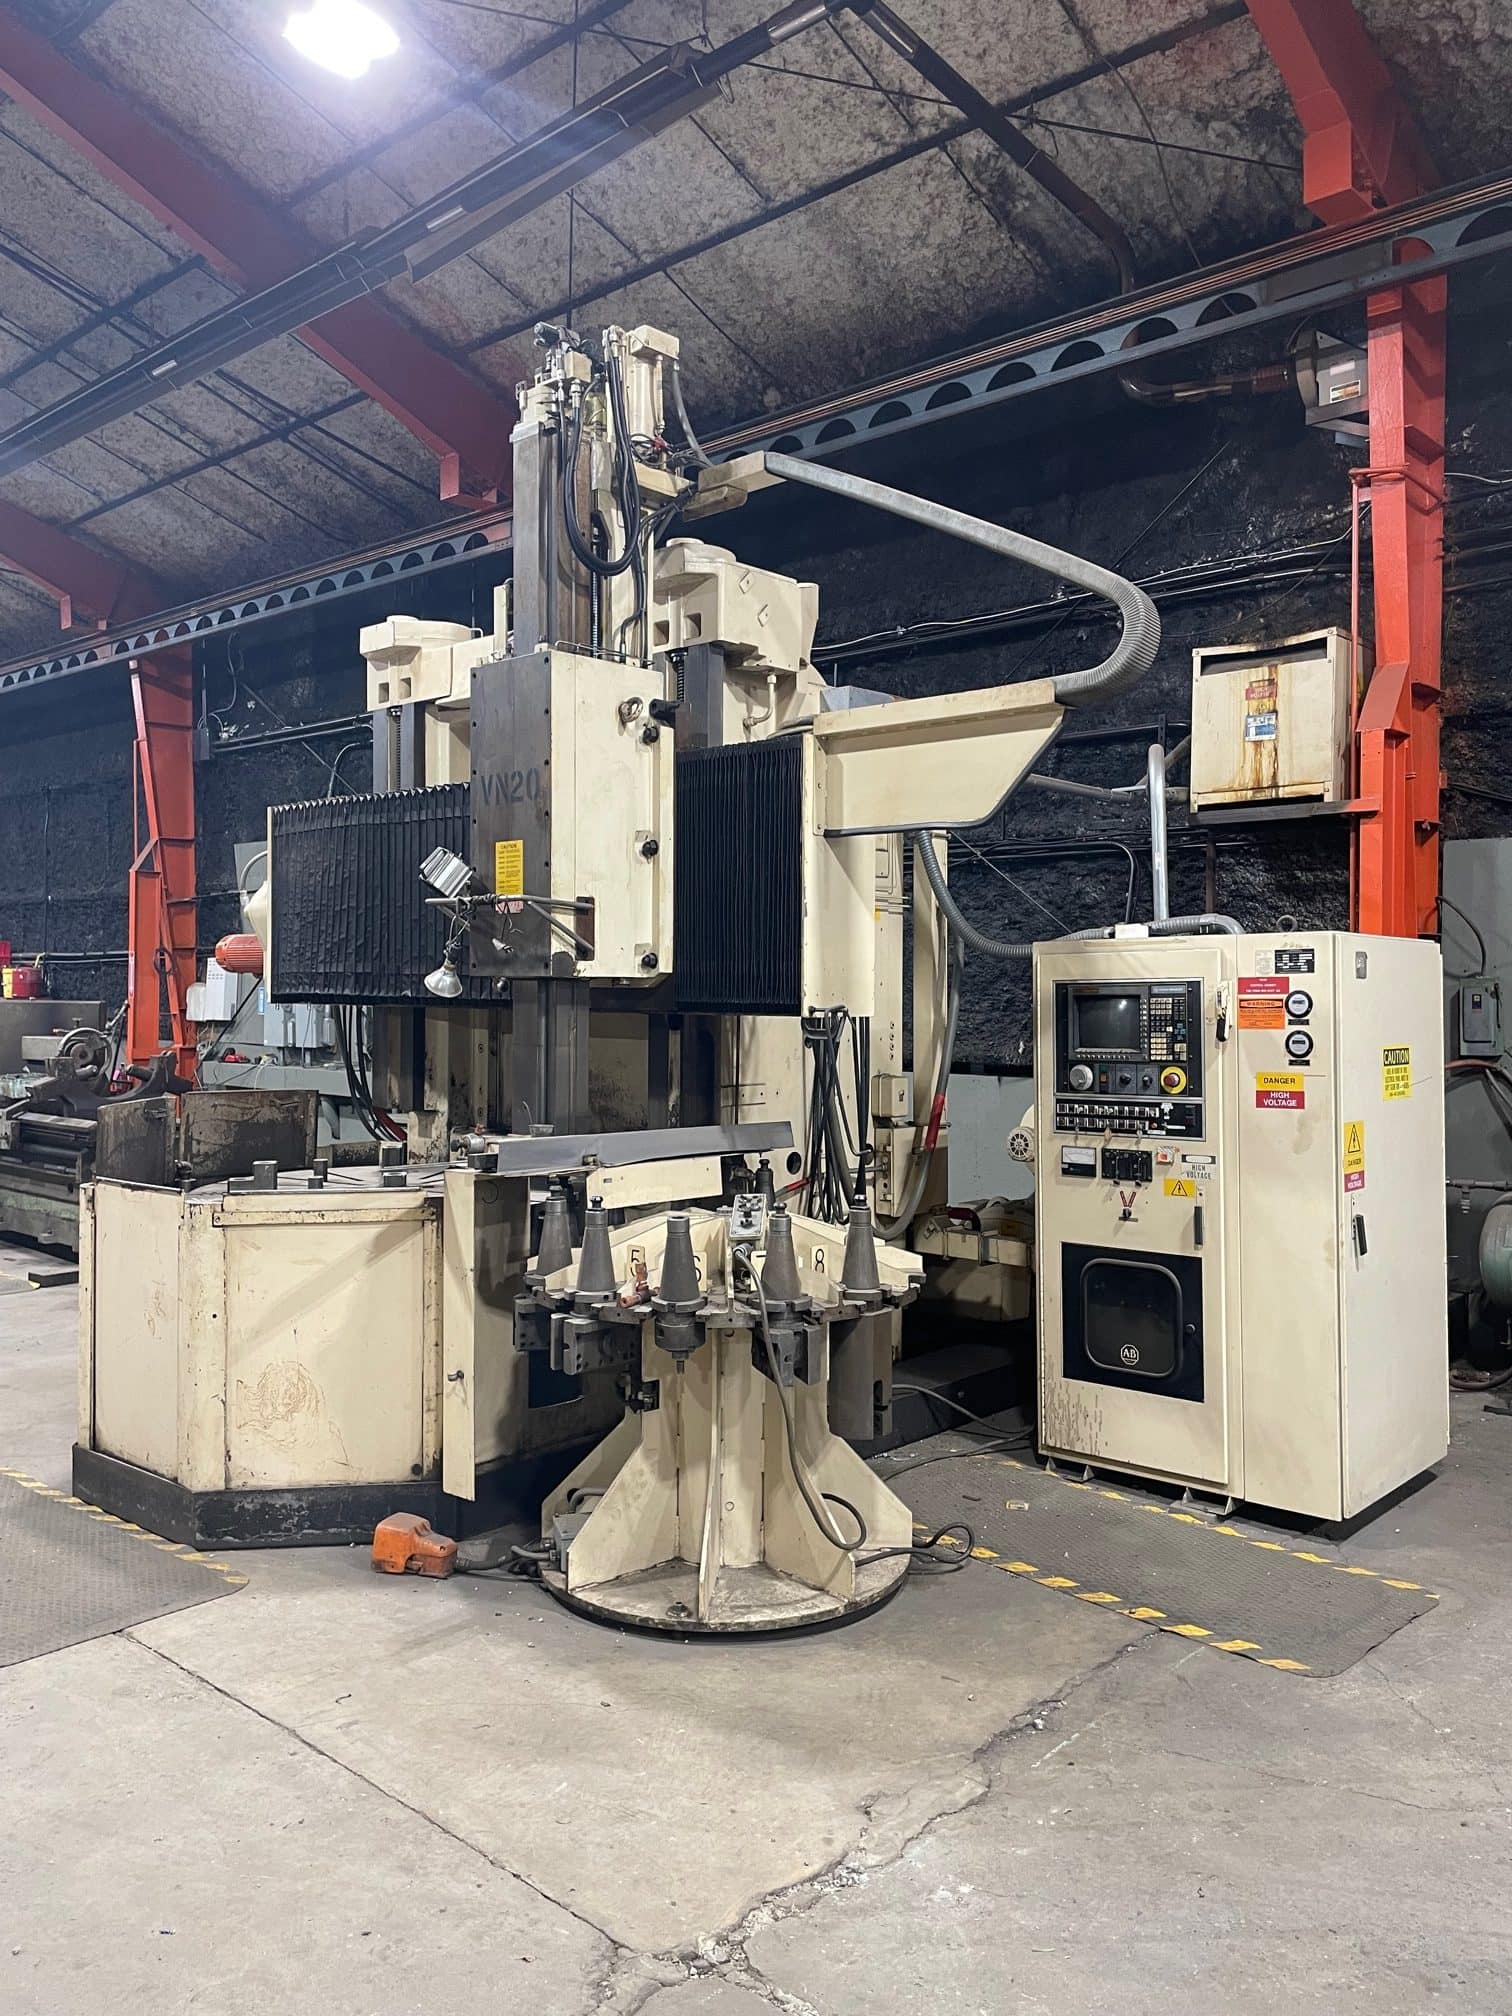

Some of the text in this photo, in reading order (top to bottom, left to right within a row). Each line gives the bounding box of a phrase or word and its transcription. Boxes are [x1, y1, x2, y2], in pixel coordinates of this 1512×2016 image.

[481, 768, 539, 806] VN20
[1384, 1049, 1408, 1065] CAUTION
[1263, 1077, 1296, 1085] DANGER
[1270, 1091, 1290, 1099] HIGH
[1263, 1098, 1297, 1107] VOLTAGE
[1186, 1171, 1211, 1180] VOLTAGE
[815, 1248, 825, 1273] 8
[1123, 1348, 1136, 1358] AB
